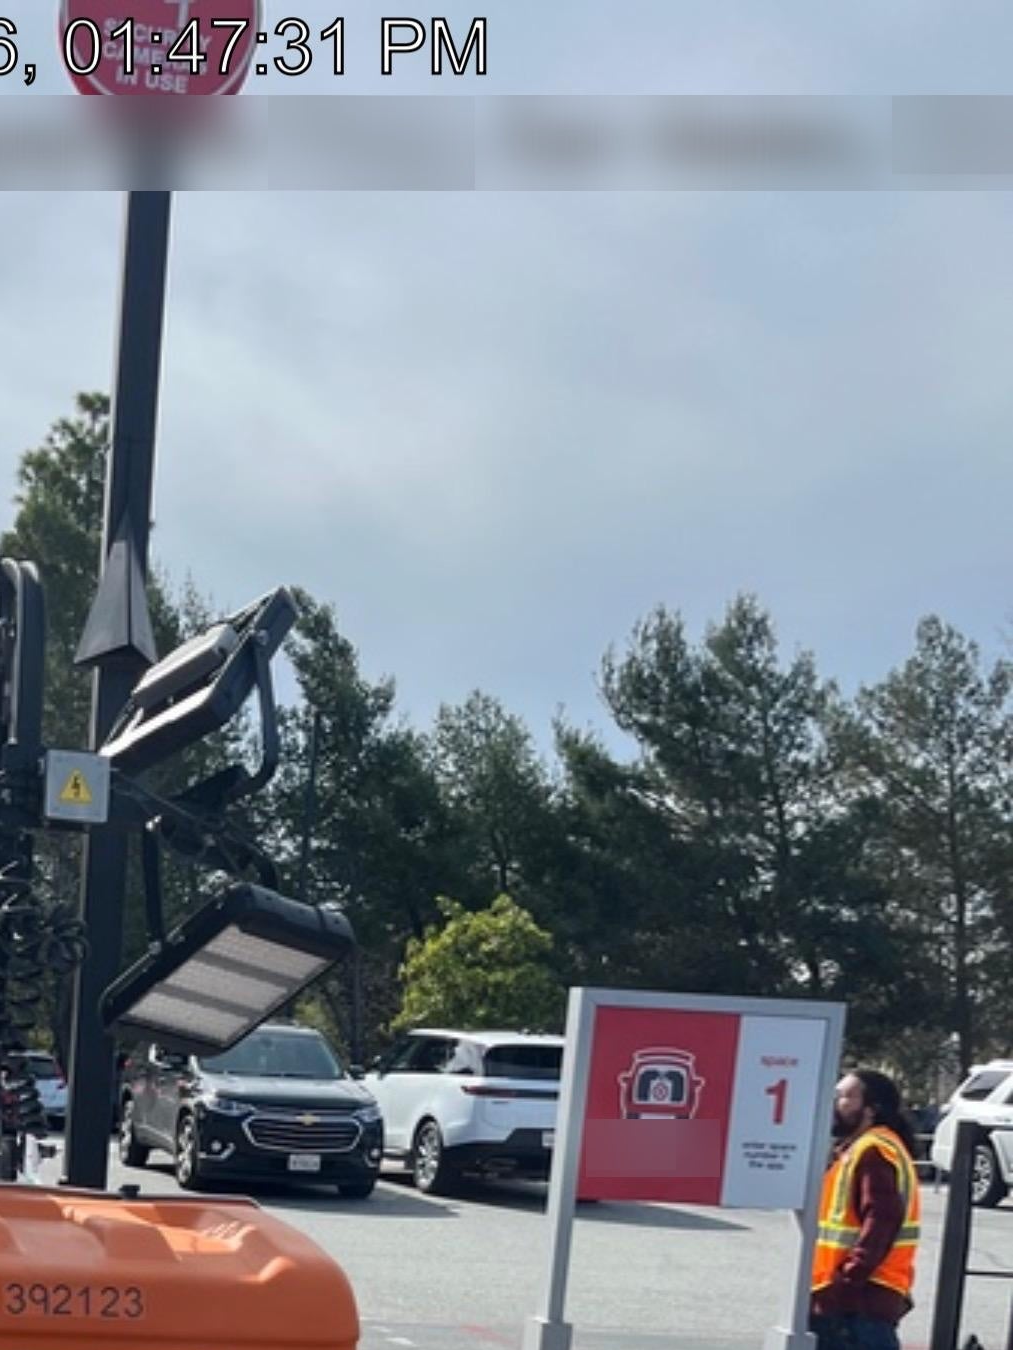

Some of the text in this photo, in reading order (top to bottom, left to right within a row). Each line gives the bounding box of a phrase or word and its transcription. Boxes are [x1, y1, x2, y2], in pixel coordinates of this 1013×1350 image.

[103, 17, 213, 51] SCURY
[146, 71, 188, 94] USE
[764, 1078, 787, 1125] 1
[5, 1282, 145, 1318] 392123
